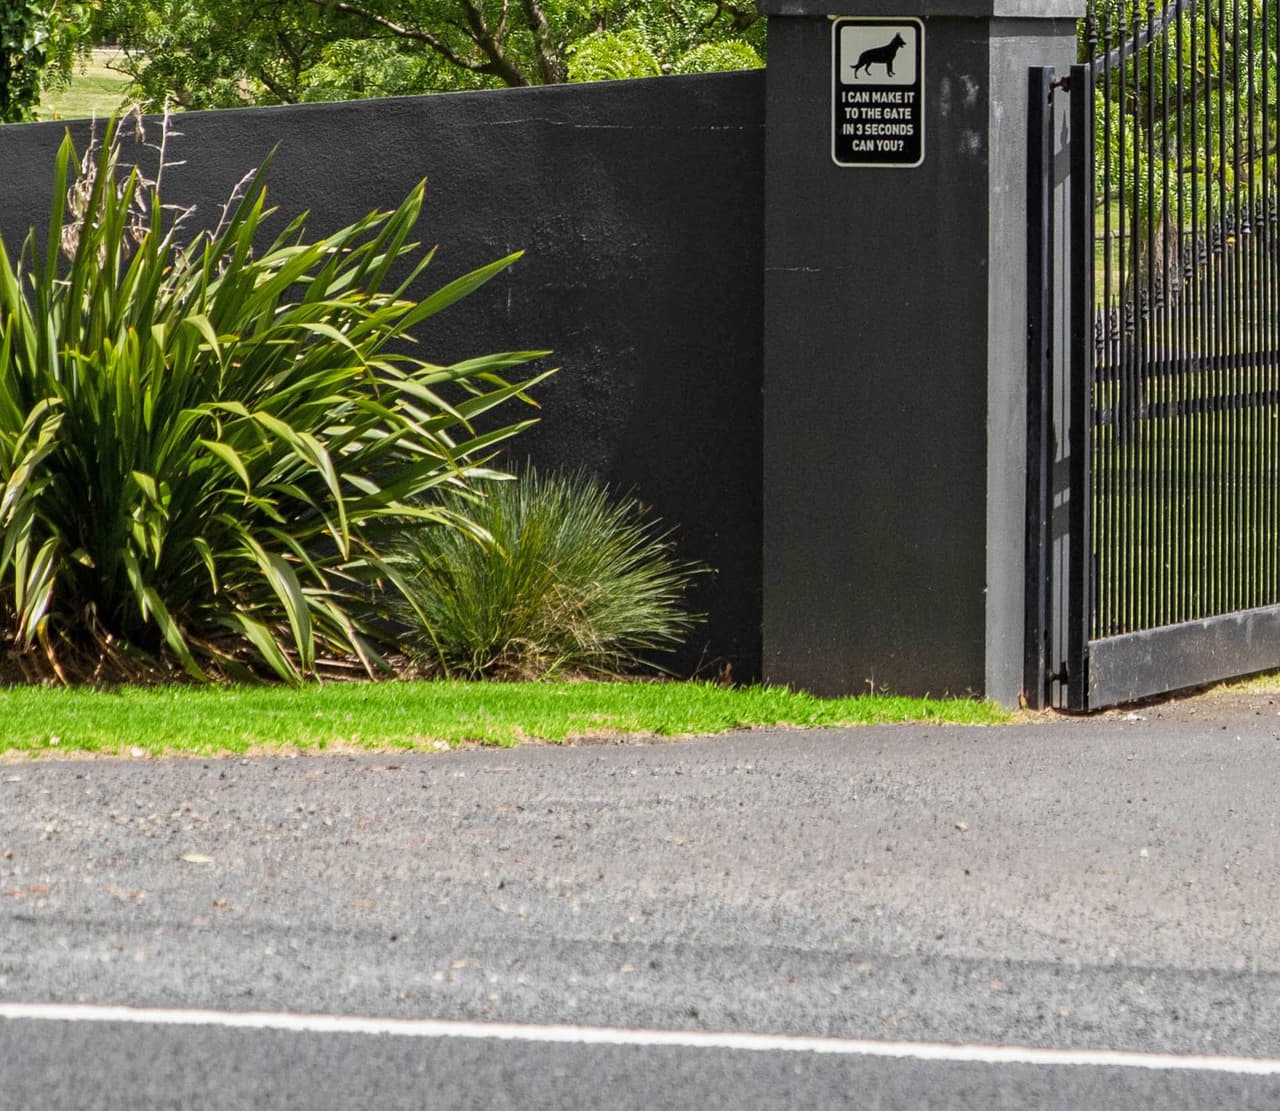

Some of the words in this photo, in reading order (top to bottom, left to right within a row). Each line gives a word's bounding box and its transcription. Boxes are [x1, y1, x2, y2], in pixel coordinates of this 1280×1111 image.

[842, 92, 846, 103] I
[848, 92, 870, 103] CAN
[872, 92, 902, 103] MAKE
[904, 92, 915, 103] IT
[844, 108, 859, 119] TO
[861, 108, 882, 119] THE
[884, 108, 912, 119] GATE
[843, 124, 854, 135] IN
[856, 124, 863, 135] 3
[865, 124, 913, 135] SECONDS
[852, 140, 874, 151] CAN
[876, 140, 904, 151] YOU?
